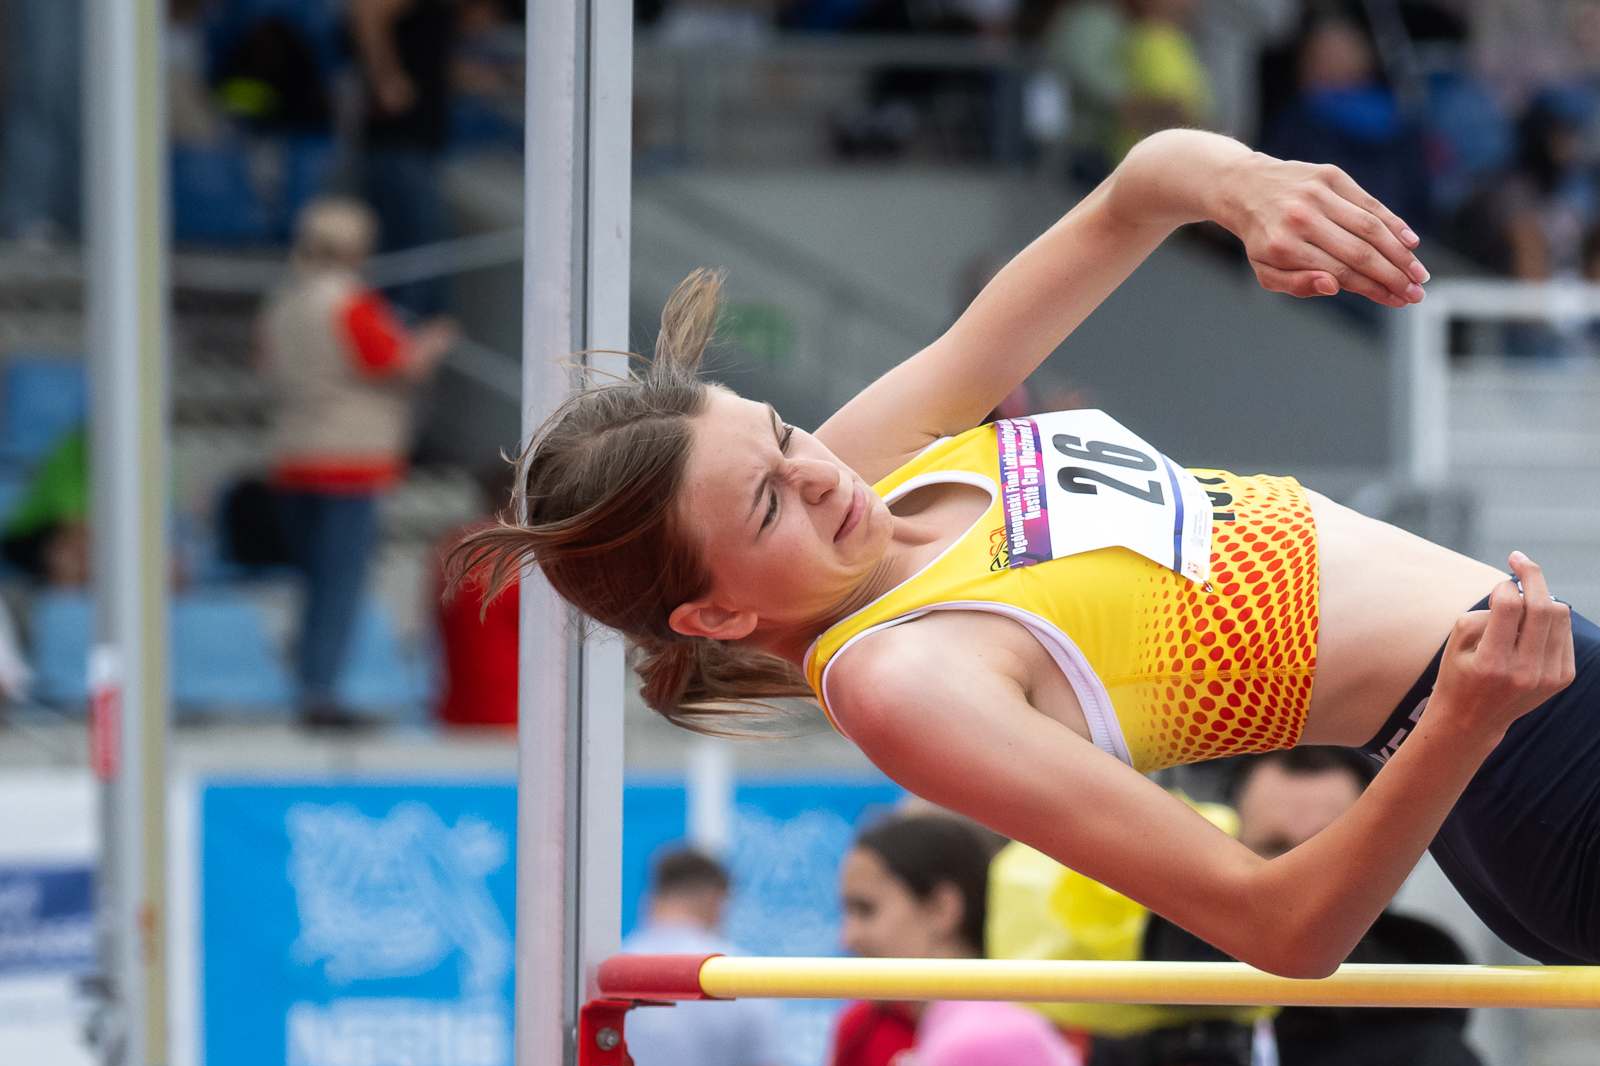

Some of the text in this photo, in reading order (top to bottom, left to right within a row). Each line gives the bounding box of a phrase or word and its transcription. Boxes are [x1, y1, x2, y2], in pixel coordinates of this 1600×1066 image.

[1004, 471, 1020, 493] Finał
[1022, 467, 1040, 486] Cup
[1052, 433, 1165, 506] 26
[1023, 486, 1041, 520] Nestlé
[1007, 493, 1028, 555] Ogólnopolski
